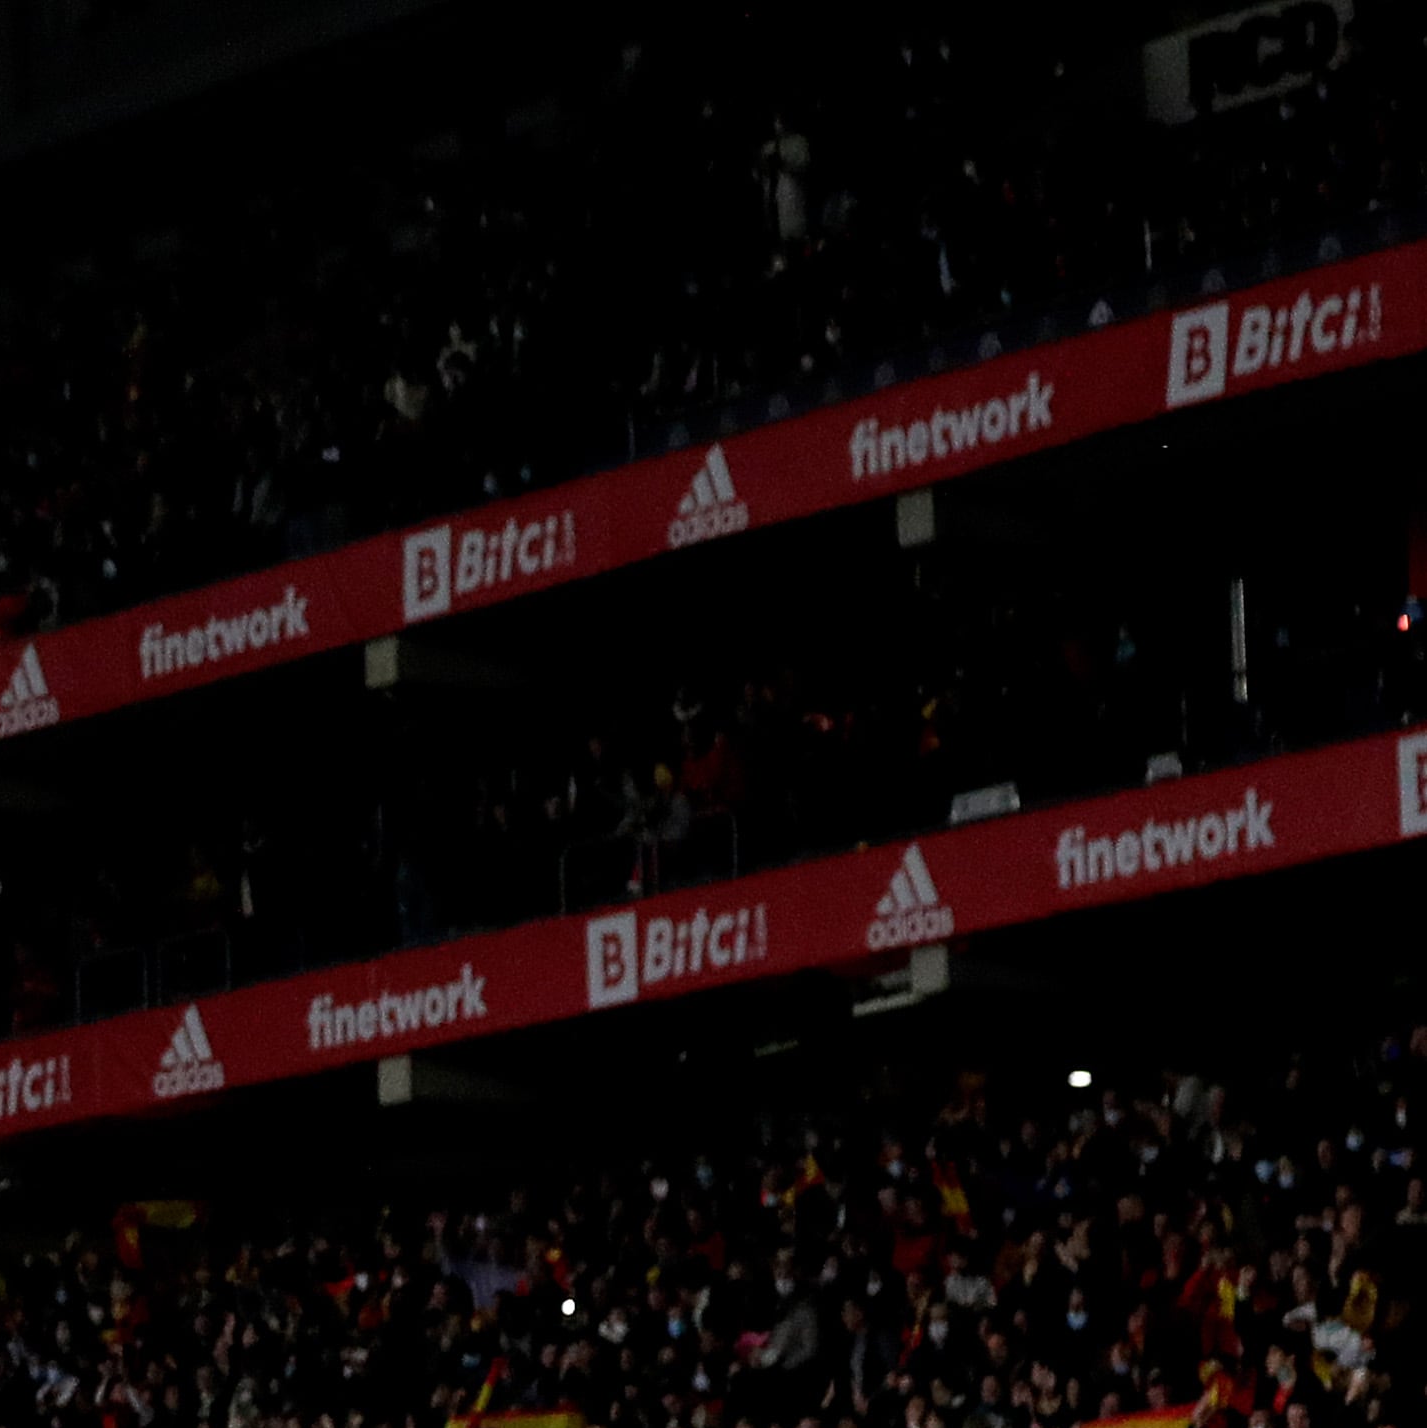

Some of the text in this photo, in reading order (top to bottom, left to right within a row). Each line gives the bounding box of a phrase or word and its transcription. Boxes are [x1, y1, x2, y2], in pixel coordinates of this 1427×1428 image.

[1233, 289, 1362, 376] Bitci
[849, 373, 1053, 479] finetwork
[455, 517, 557, 594] Bitci
[668, 501, 749, 548] adidas
[139, 586, 308, 678] finetwork
[1055, 789, 1274, 888] finetwork
[643, 909, 749, 983] Bitci
[867, 907, 954, 951] adidas
[307, 964, 487, 1049] finetwork
